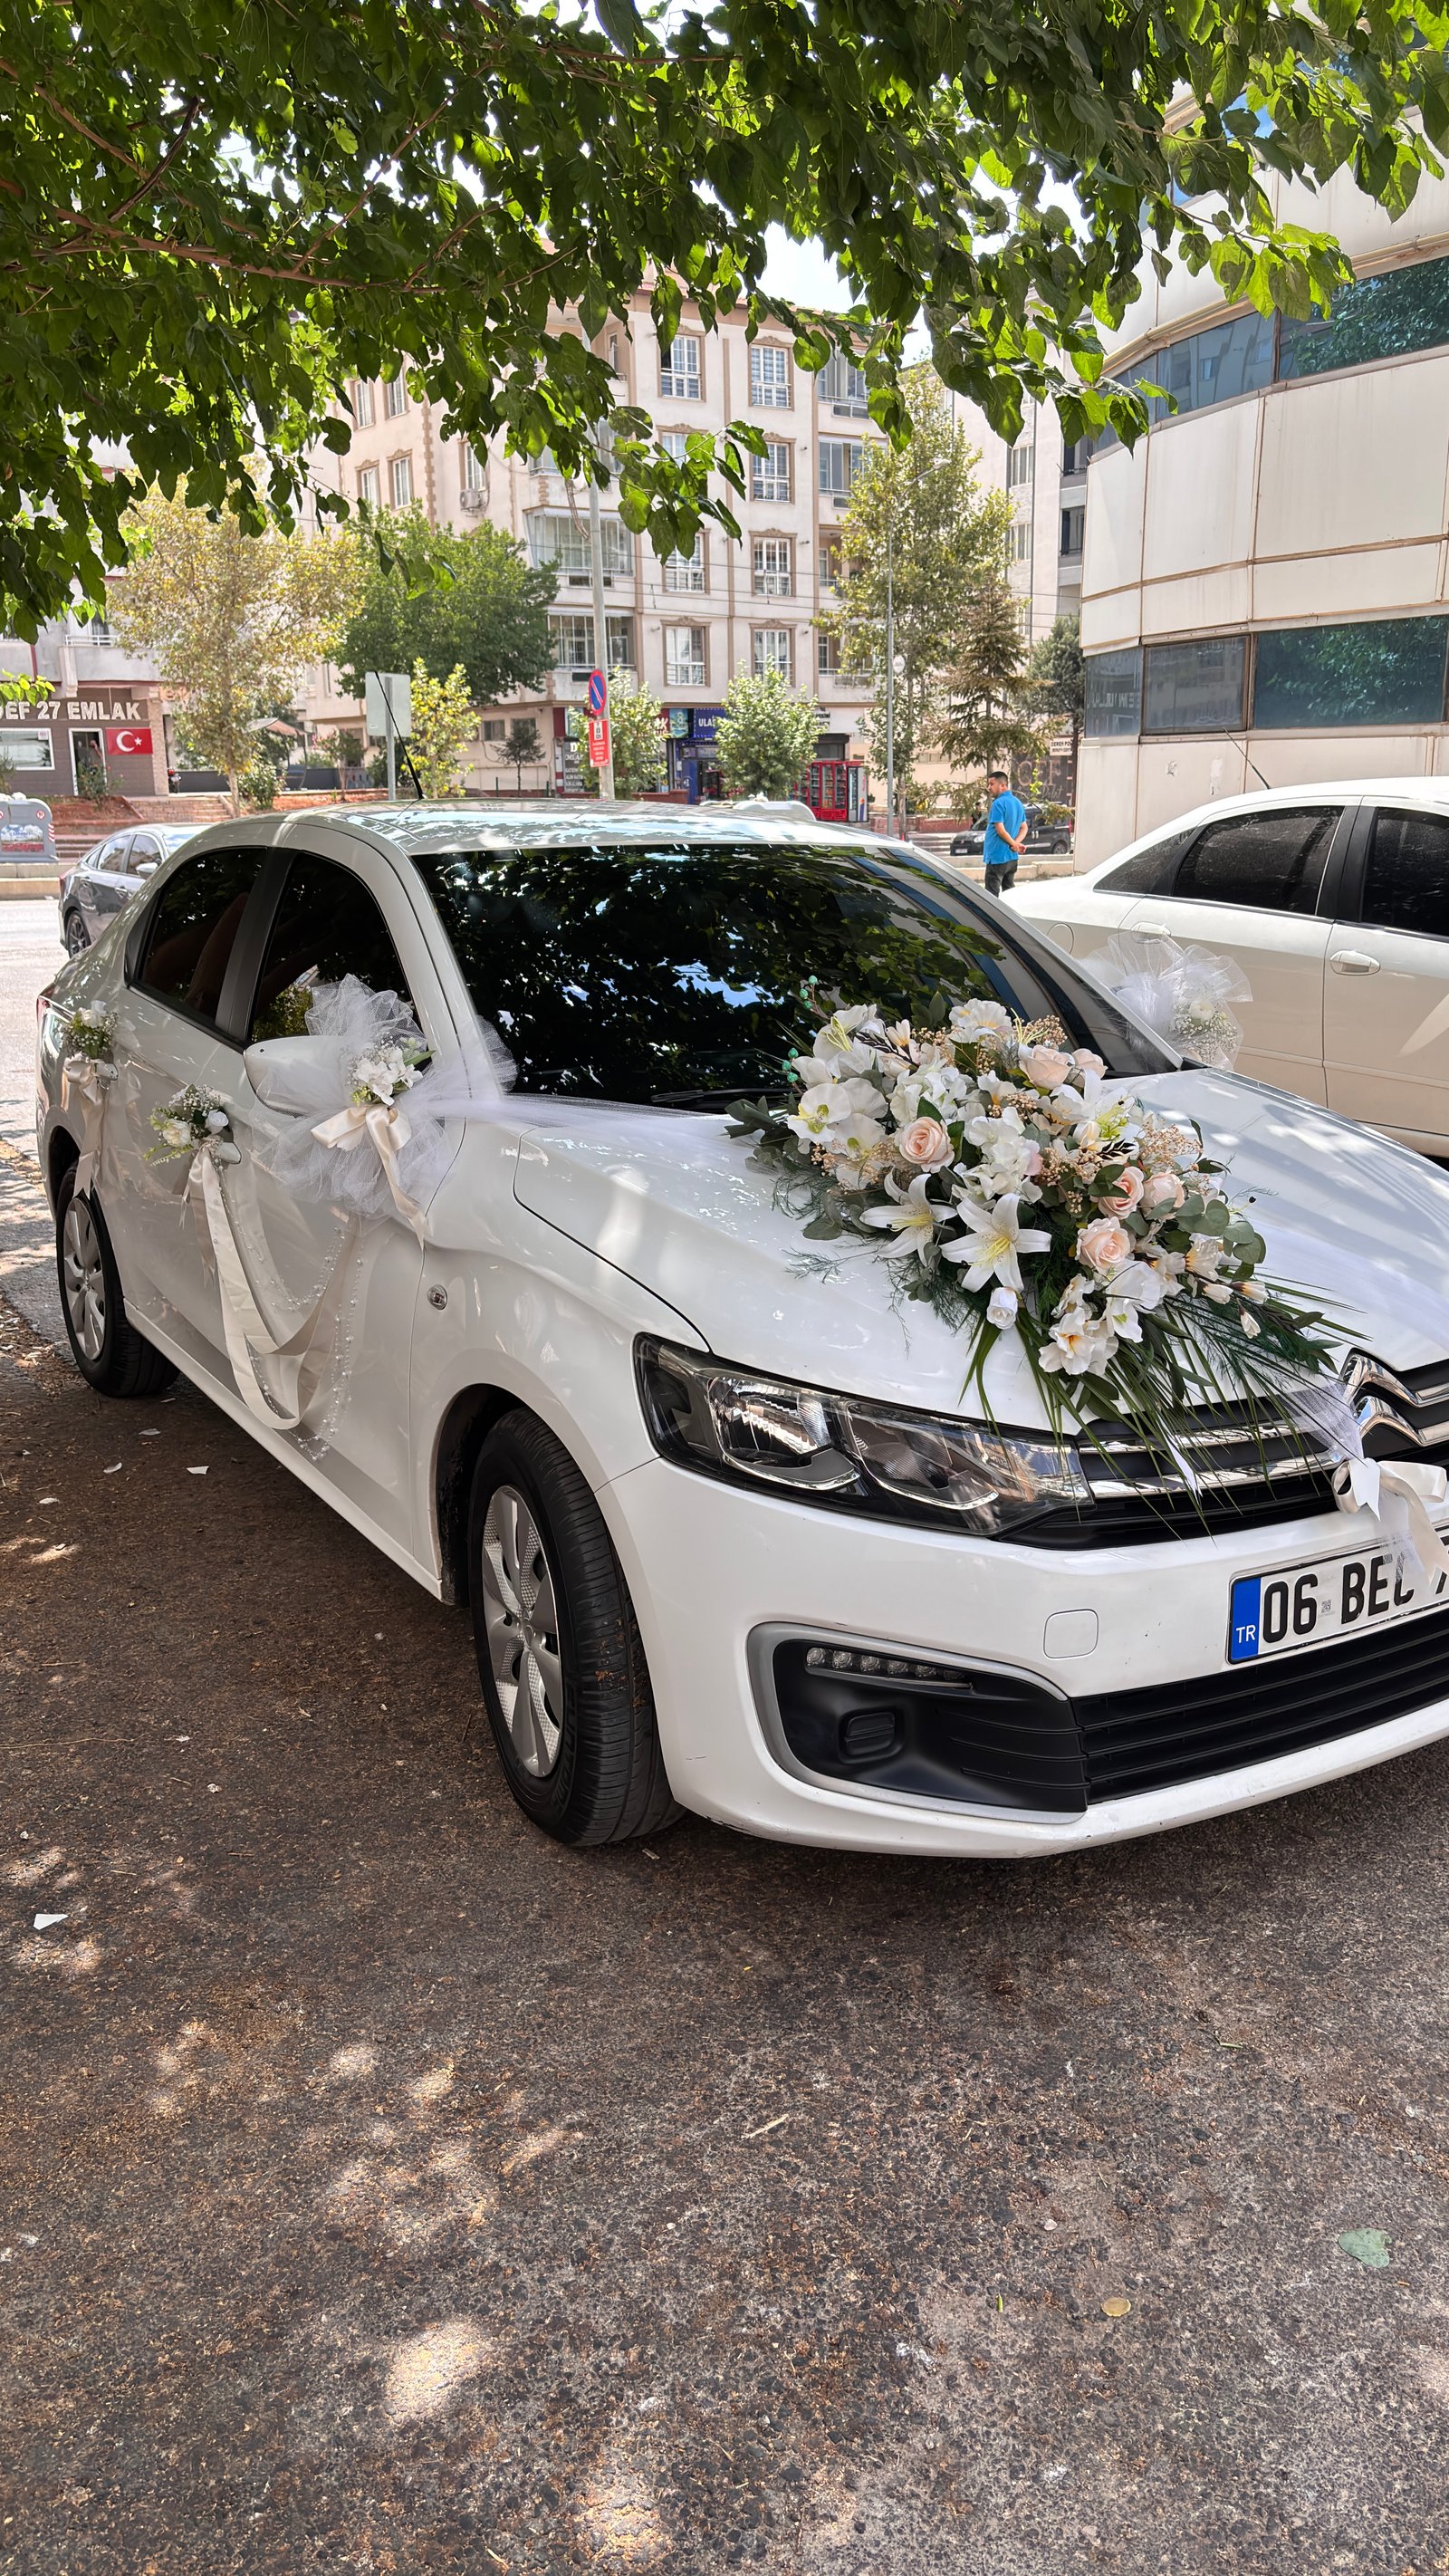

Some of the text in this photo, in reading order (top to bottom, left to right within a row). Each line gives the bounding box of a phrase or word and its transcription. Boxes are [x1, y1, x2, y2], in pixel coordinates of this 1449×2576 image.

[0, 701, 141, 720] EF 27 EMLAK
[1263, 1573, 1319, 1644] 06
[1235, 1624, 1257, 1644] TR
